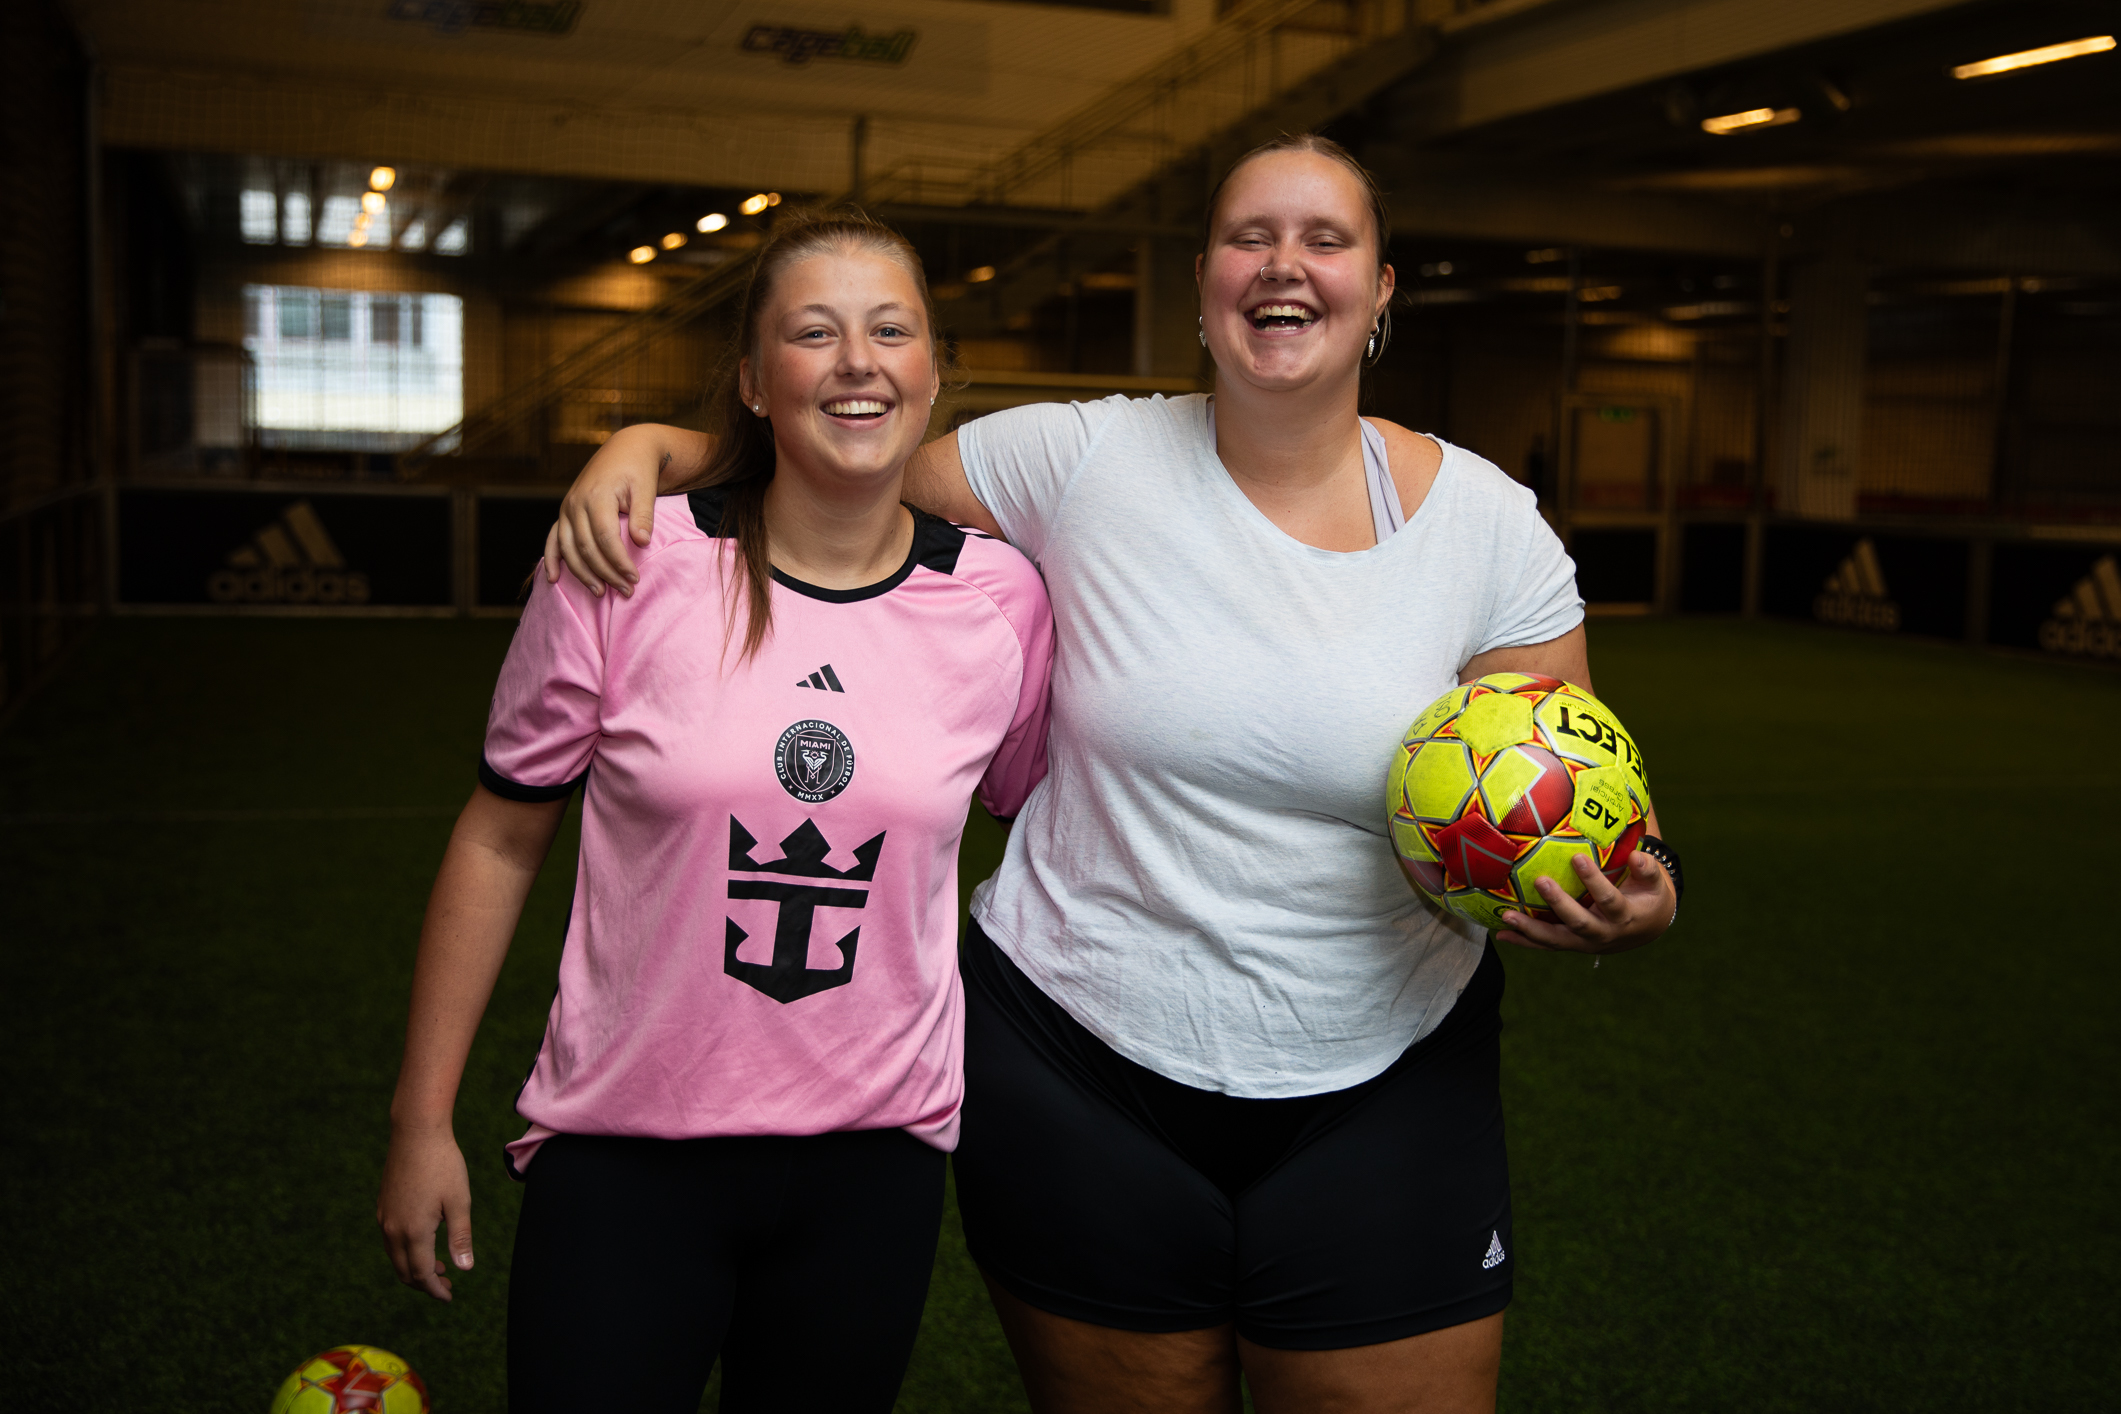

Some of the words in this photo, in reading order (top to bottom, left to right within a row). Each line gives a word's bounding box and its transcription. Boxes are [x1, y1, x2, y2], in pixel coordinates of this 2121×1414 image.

[741, 25, 917, 66] cageball
[207, 567, 372, 604] adidas
[777, 721, 841, 752] INTERNACIONAL
[800, 739, 831, 750] MIAMI
[841, 740, 851, 752] DE
[777, 756, 787, 780] CLUB
[797, 791, 824, 801] MMXX
[1590, 784, 1624, 812] Artificial
[1582, 797, 1620, 830] AG
